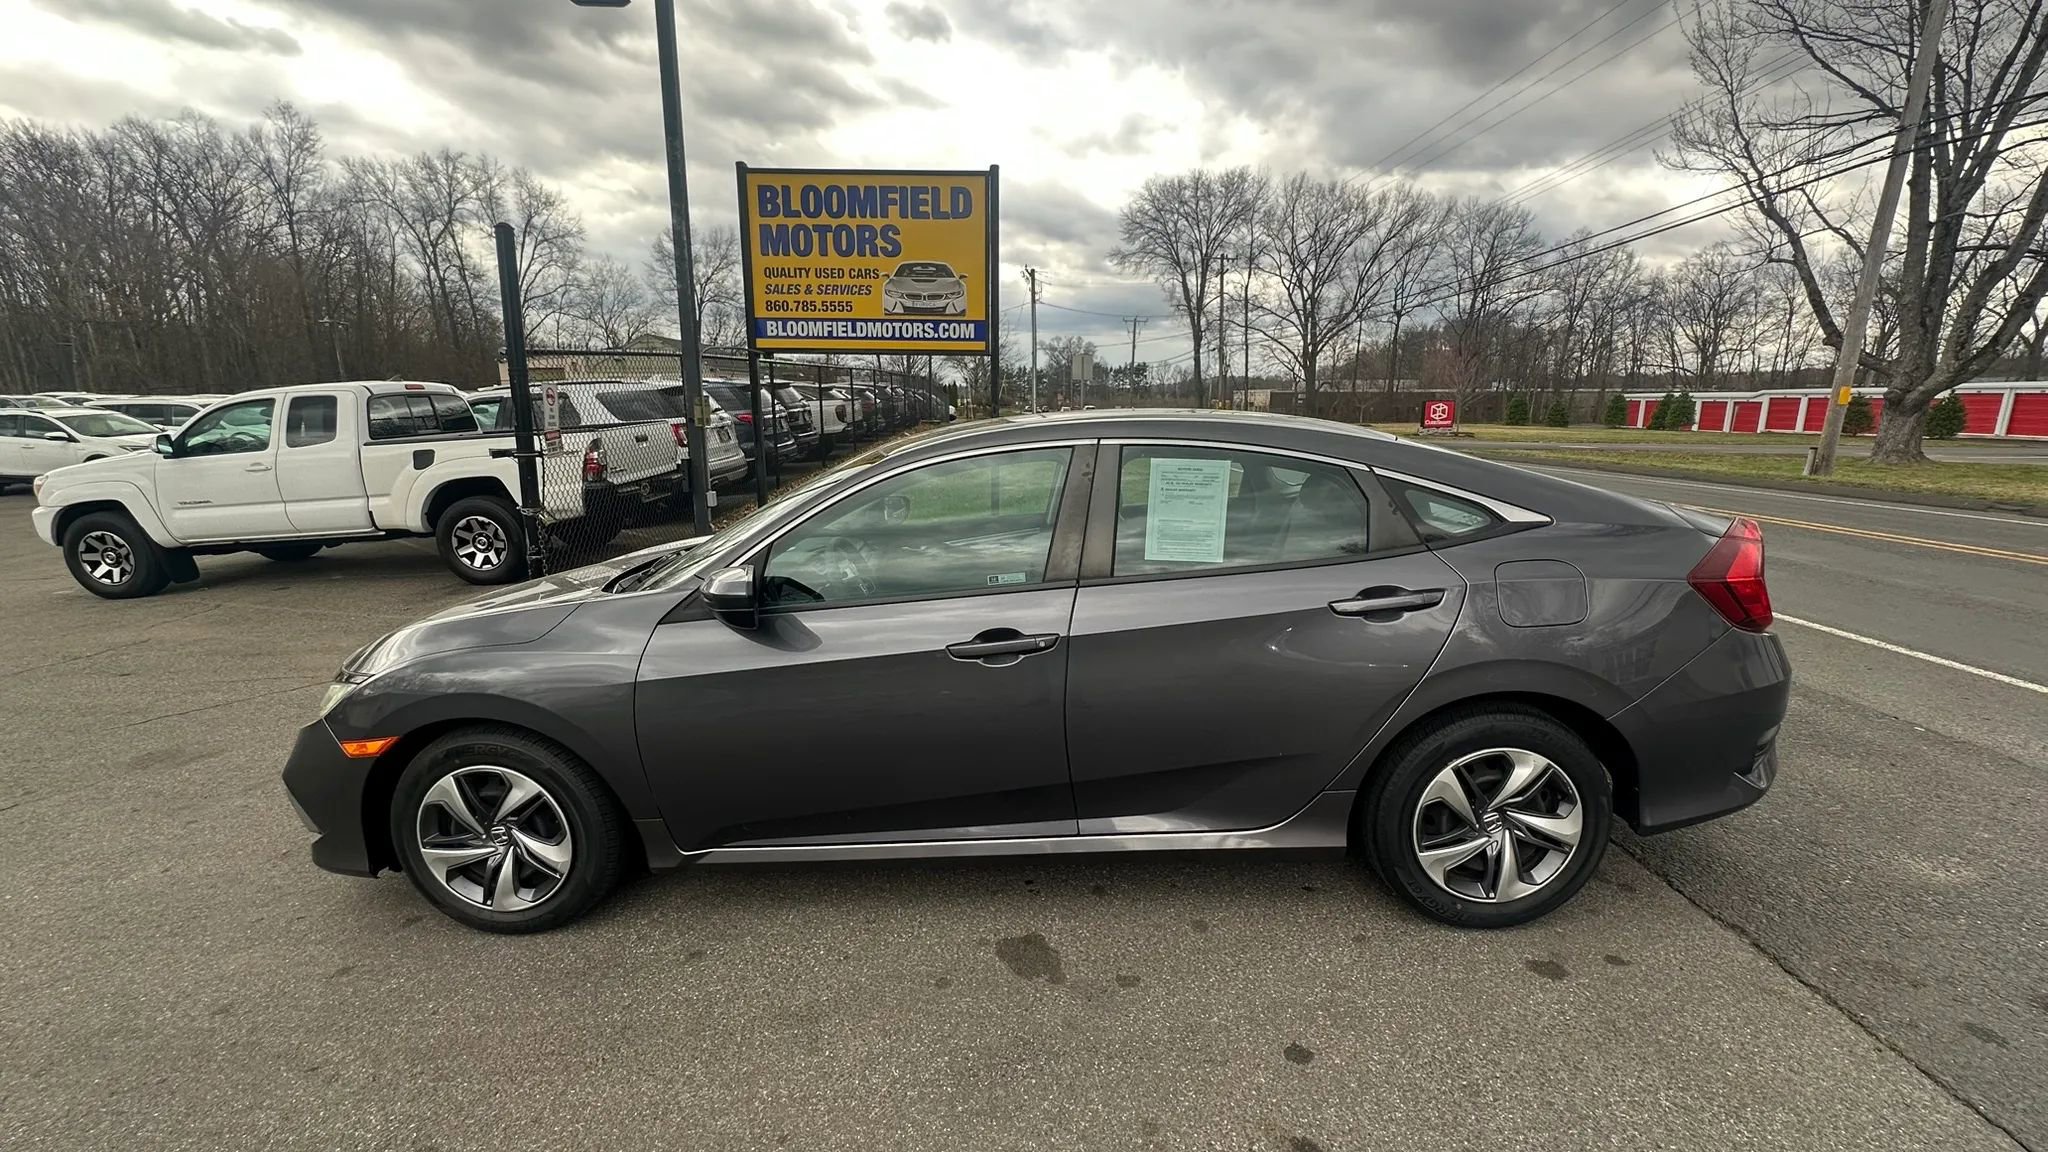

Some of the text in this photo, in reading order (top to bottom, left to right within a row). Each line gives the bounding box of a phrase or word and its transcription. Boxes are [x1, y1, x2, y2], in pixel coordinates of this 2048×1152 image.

[757, 184, 973, 220] BLOOMFIELD
[758, 223, 902, 258] MOTORS
[764, 267, 880, 280] QUALITY USED CARS
[765, 284, 872, 296] SALES & SERVICES
[765, 300, 853, 312] 860.785.5555
[766, 320, 975, 339] BLOOMFIELDMOTORS.COM
